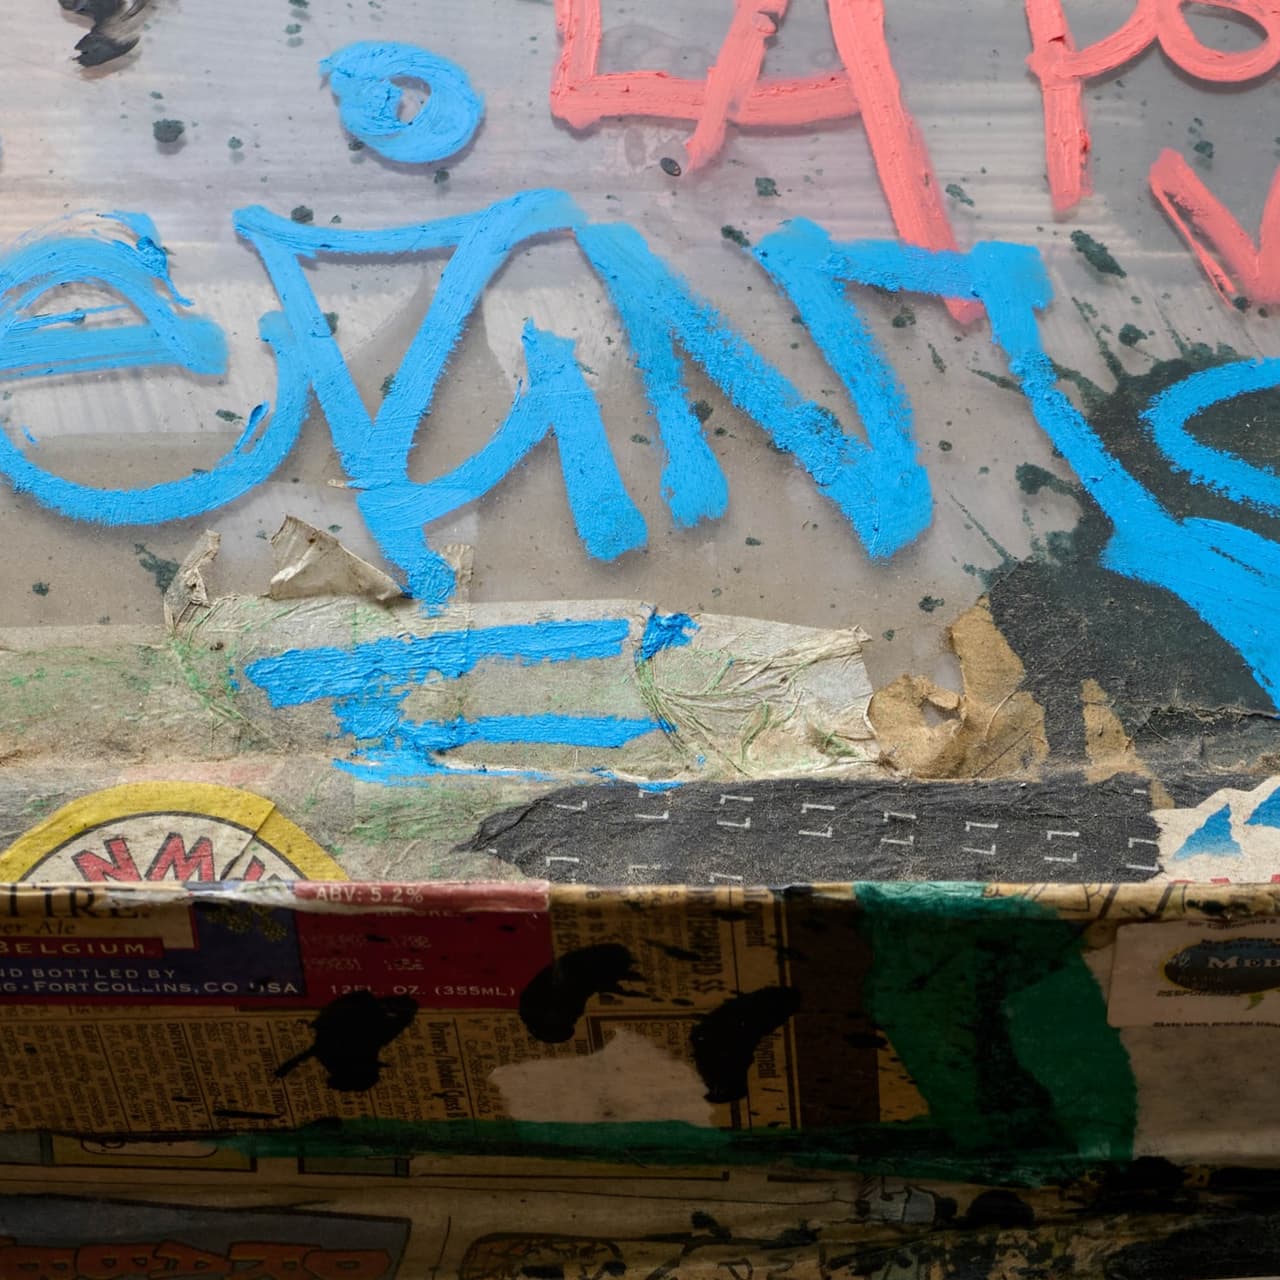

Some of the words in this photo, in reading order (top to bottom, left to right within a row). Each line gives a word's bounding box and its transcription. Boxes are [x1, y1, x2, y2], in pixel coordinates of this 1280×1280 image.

[34, 920, 77, 935] Ale
[31, 967, 139, 980] BOTTLED
[147, 968, 176, 980] BY
[32, 980, 90, 994] FORT
[203, 981, 239, 995] CO
